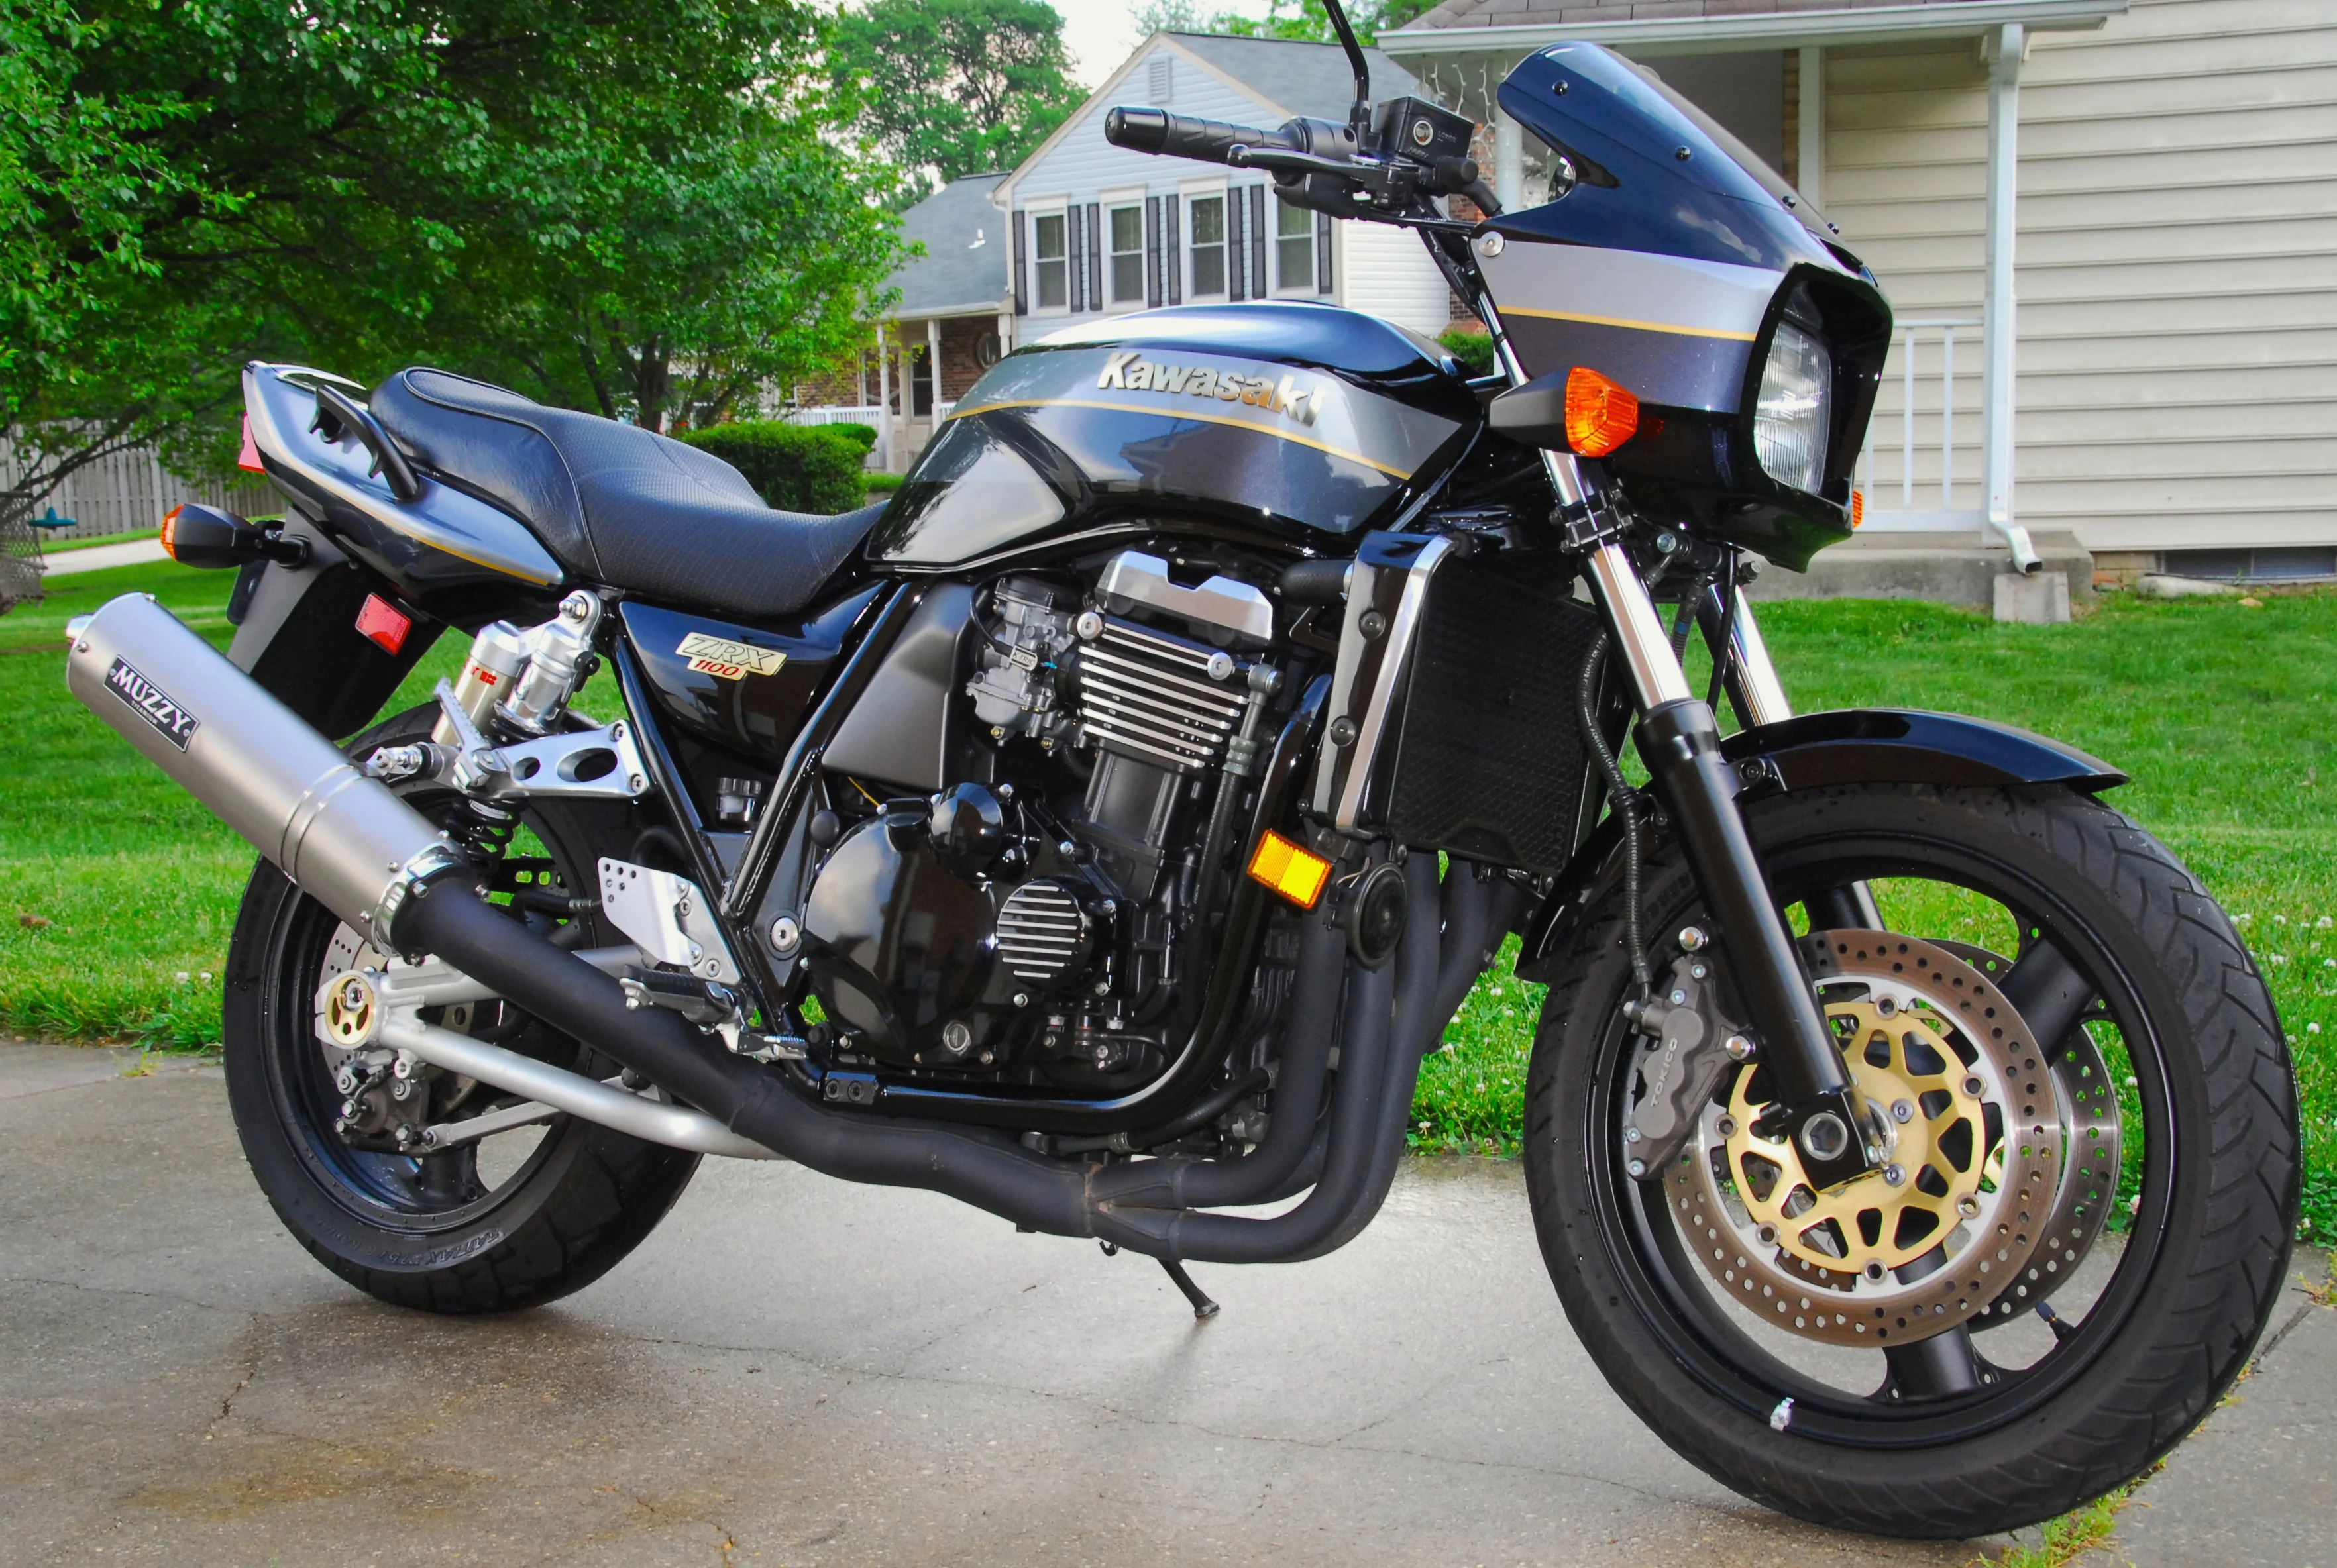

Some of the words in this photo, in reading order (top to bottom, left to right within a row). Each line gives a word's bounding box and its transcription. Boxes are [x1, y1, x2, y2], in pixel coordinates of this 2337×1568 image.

[1097, 352, 1326, 427] Kawasaki
[683, 637, 775, 671] ZRX
[695, 659, 739, 676] 1100
[112, 664, 191, 733] MUZZY
[131, 700, 158, 725] TITANIUM
[1651, 1037, 1678, 1107] TOKICO
